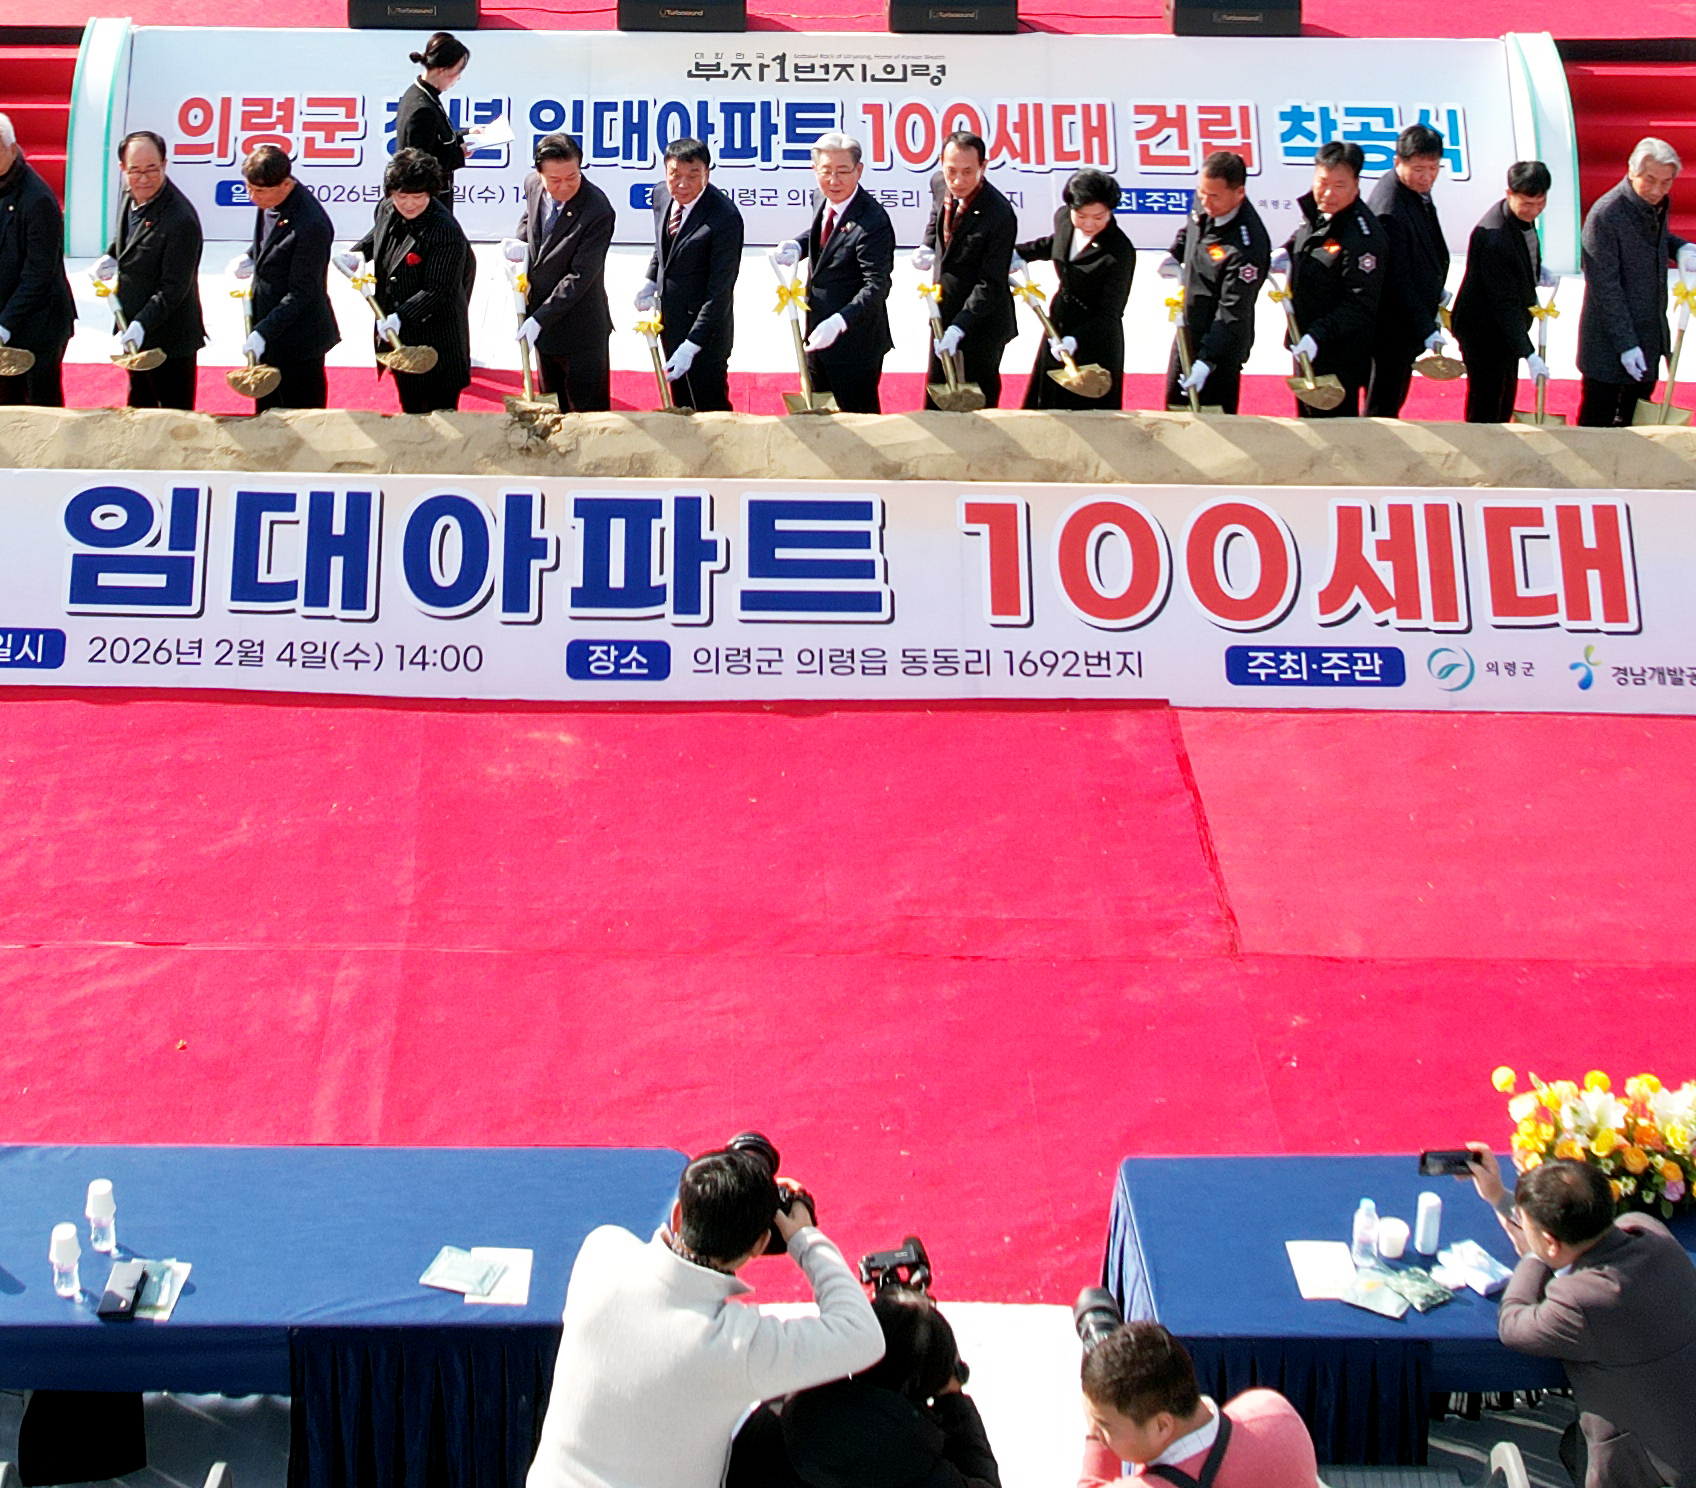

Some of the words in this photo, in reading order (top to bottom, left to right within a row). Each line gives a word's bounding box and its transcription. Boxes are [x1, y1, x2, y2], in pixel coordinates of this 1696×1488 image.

[173, 96, 359, 162] 의령군
[528, 98, 842, 165] 임대아파트
[862, 102, 1103, 167] 100세대
[1134, 104, 1254, 168] 건립
[63, 486, 884, 619] 임대아파트
[964, 501, 1630, 623] 100세대
[87, 635, 203, 666] 2026년
[214, 638, 265, 668] 2월
[275, 640, 384, 672] 4일(수)
[395, 644, 484, 673] 14:00
[588, 644, 649, 675] 장소
[692, 646, 785, 676] 의령군
[796, 647, 888, 677] 의령읍
[900, 648, 991, 677] 동동리
[1003, 649, 1143, 679] 1692번지
[1247, 651, 1384, 682] 주최·주관
[1486, 661, 1535, 677] 의령군
